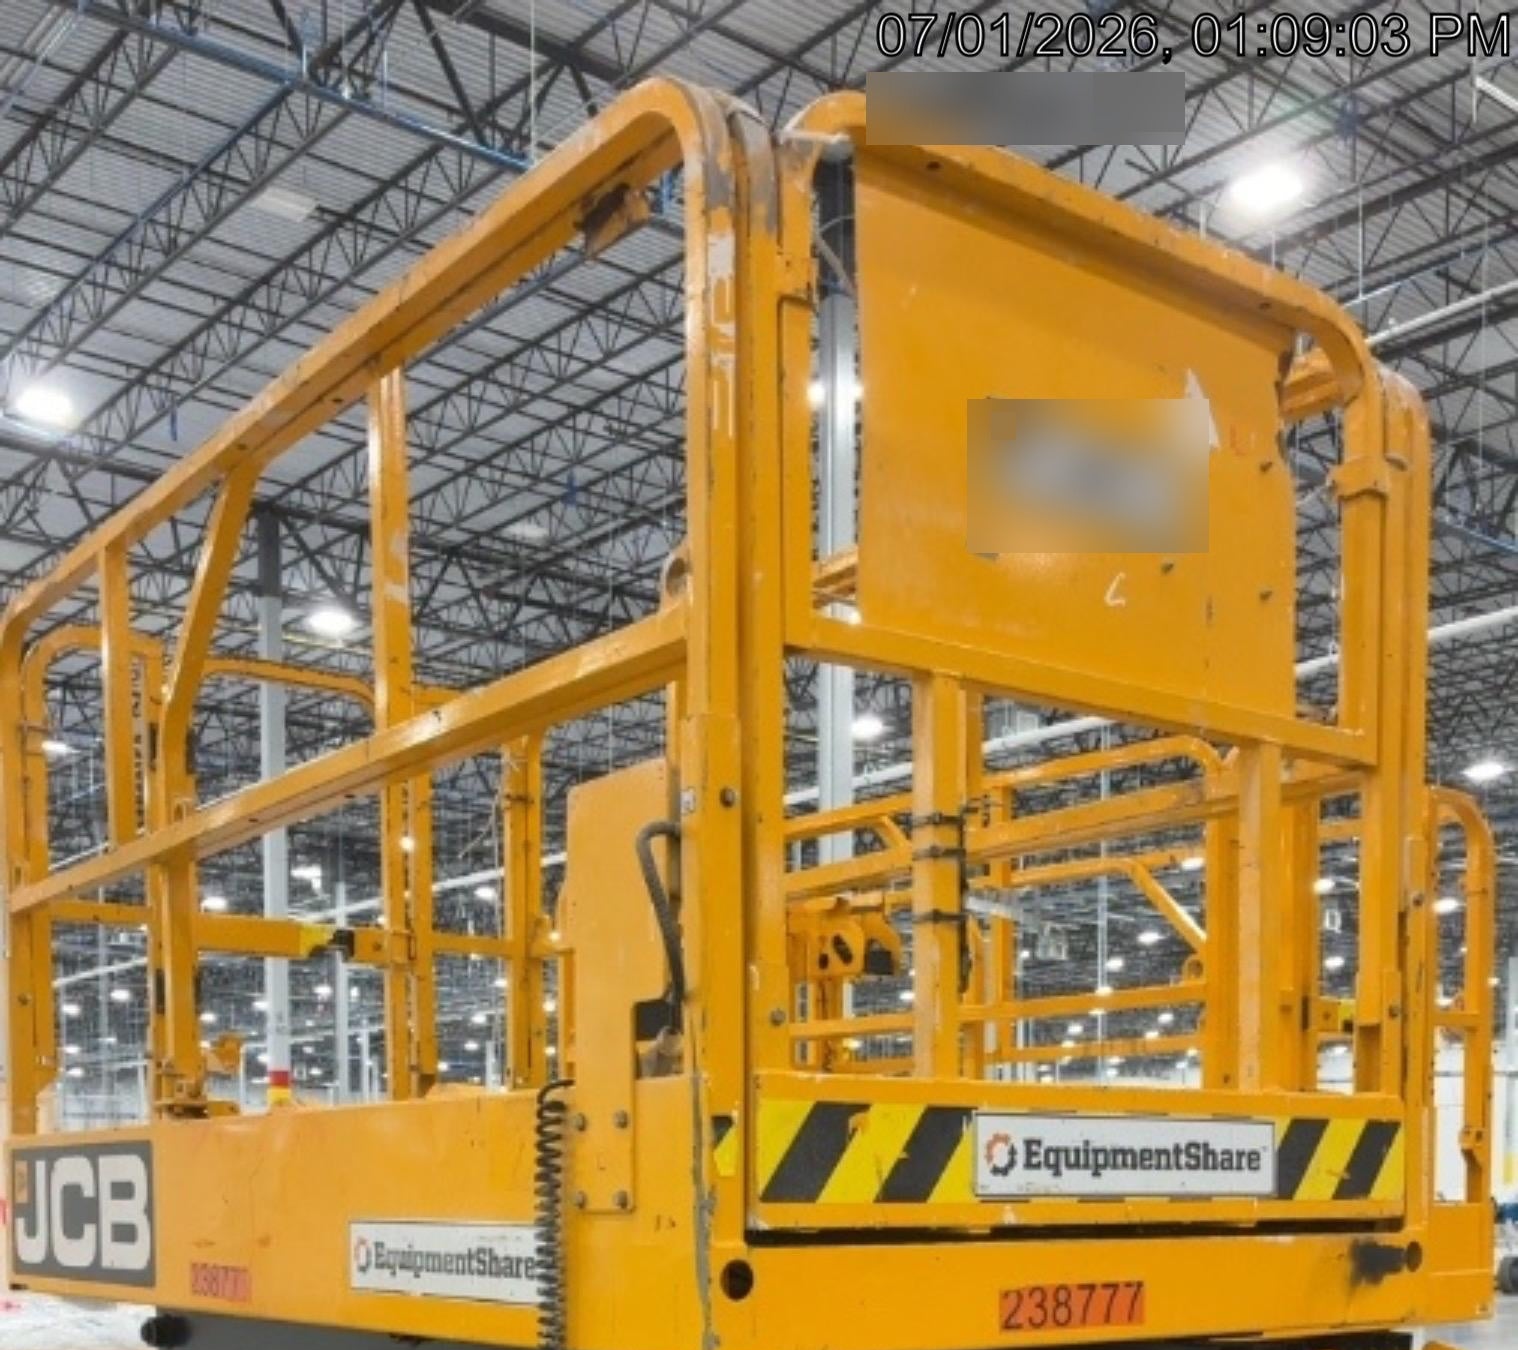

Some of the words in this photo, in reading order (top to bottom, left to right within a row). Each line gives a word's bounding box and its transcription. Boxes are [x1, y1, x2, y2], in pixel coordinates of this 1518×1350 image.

[1022, 1138, 1261, 1177] EquipmentShare
[15, 1153, 152, 1270] JCB
[373, 1240, 537, 1280] EquipmentShare
[1001, 1280, 1144, 1330] 238777
